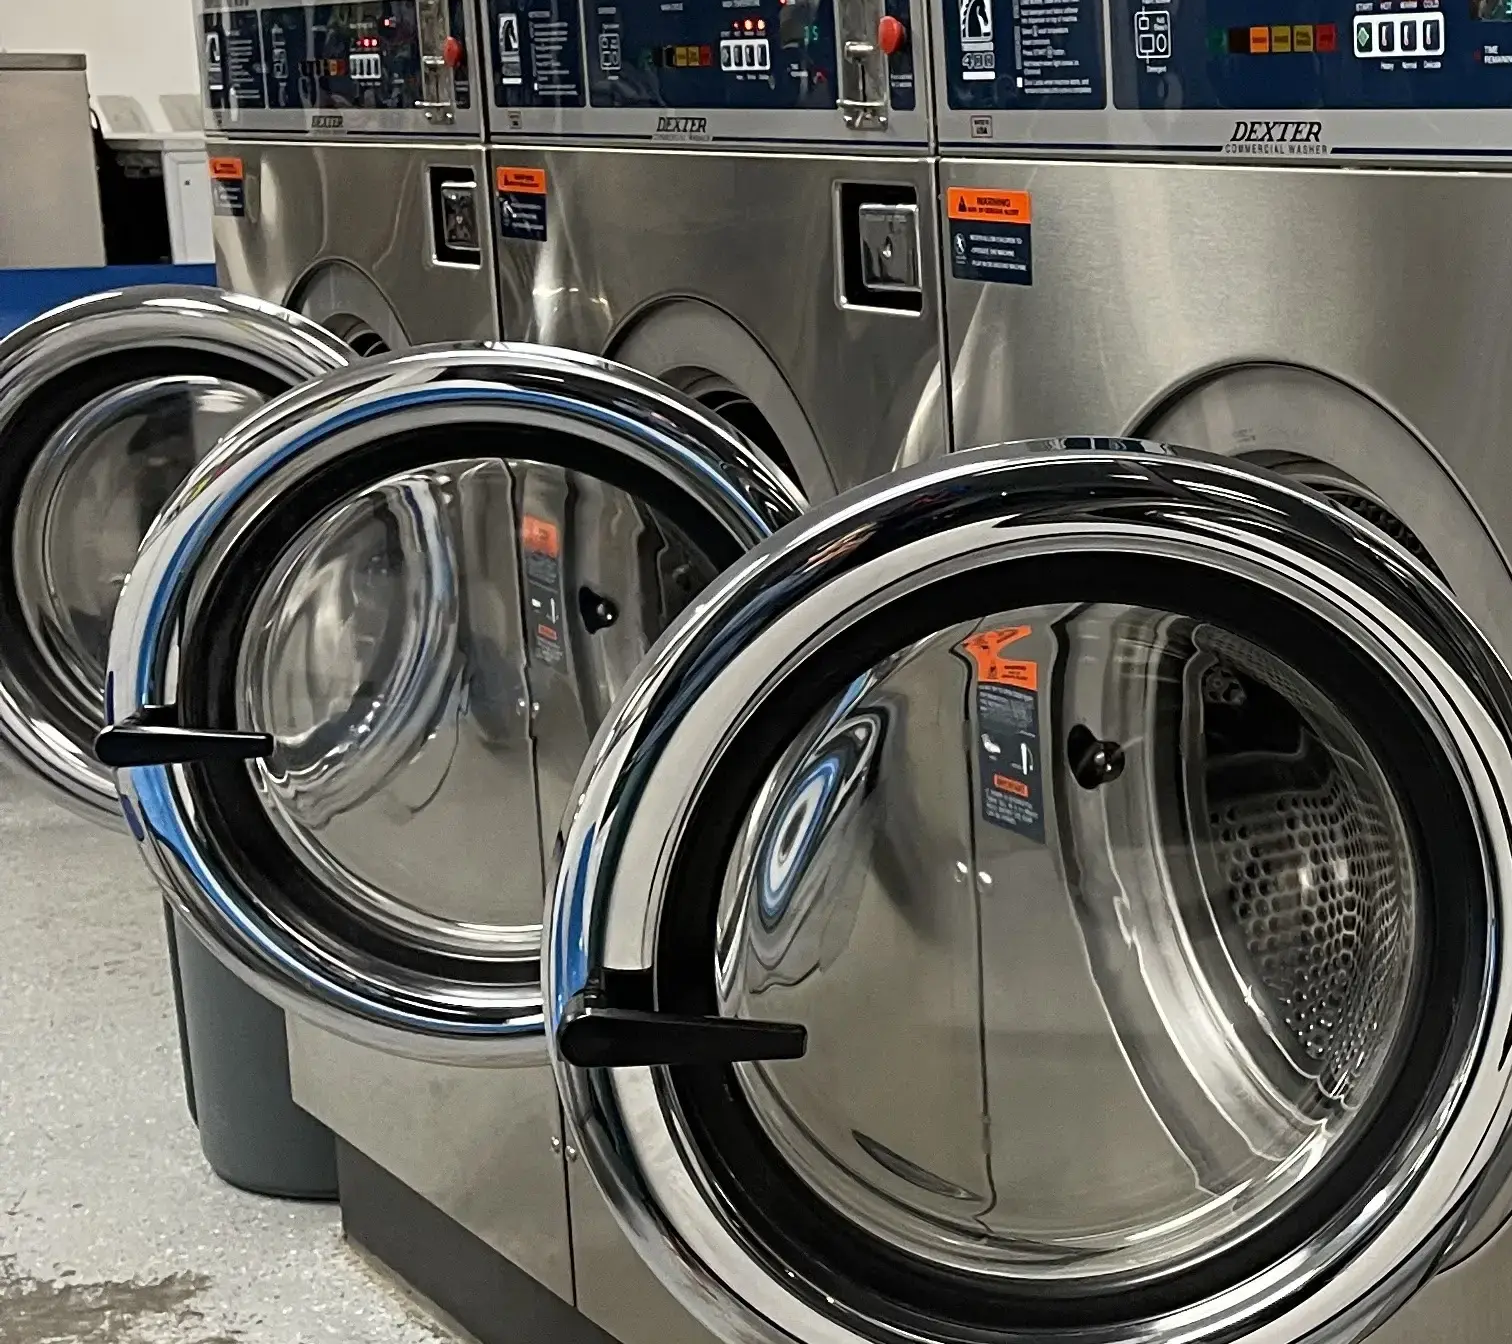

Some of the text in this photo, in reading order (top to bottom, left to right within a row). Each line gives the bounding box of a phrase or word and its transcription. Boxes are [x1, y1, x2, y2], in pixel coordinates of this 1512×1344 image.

[656, 117, 706, 133] DEXTER
[1230, 122, 1322, 142] DEXTER
[1225, 144, 1327, 154] COMMERCIAL WASHER
